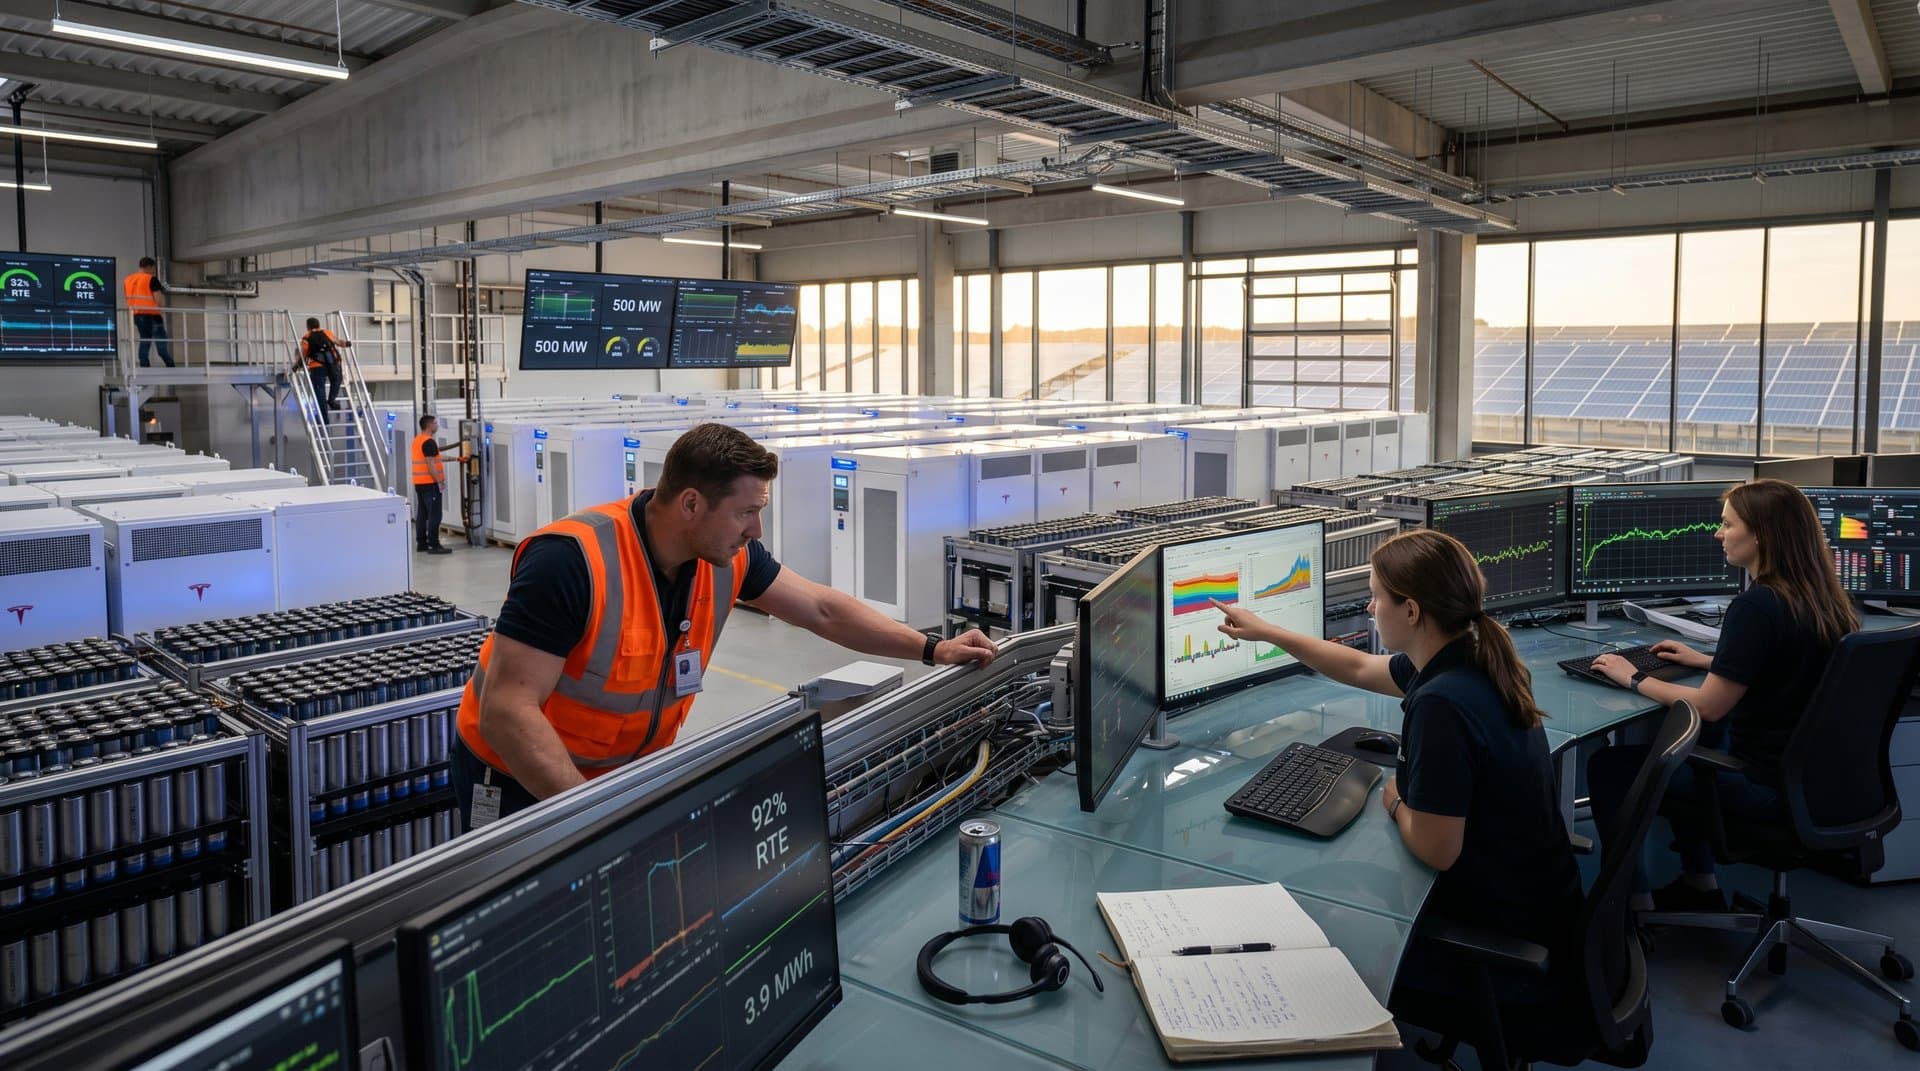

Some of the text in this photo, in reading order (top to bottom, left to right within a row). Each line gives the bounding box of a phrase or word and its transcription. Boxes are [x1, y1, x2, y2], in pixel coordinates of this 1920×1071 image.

[10, 278, 29, 287] 32%
[75, 281, 94, 289] 32%
[12, 289, 30, 297] RTE
[77, 291, 95, 299] RTE
[613, 299, 661, 312] 500 MW
[535, 340, 587, 352] 500 MW
[751, 792, 787, 832] 92%
[756, 826, 789, 870] RTE
[745, 947, 813, 1024] 3.9 MWh
